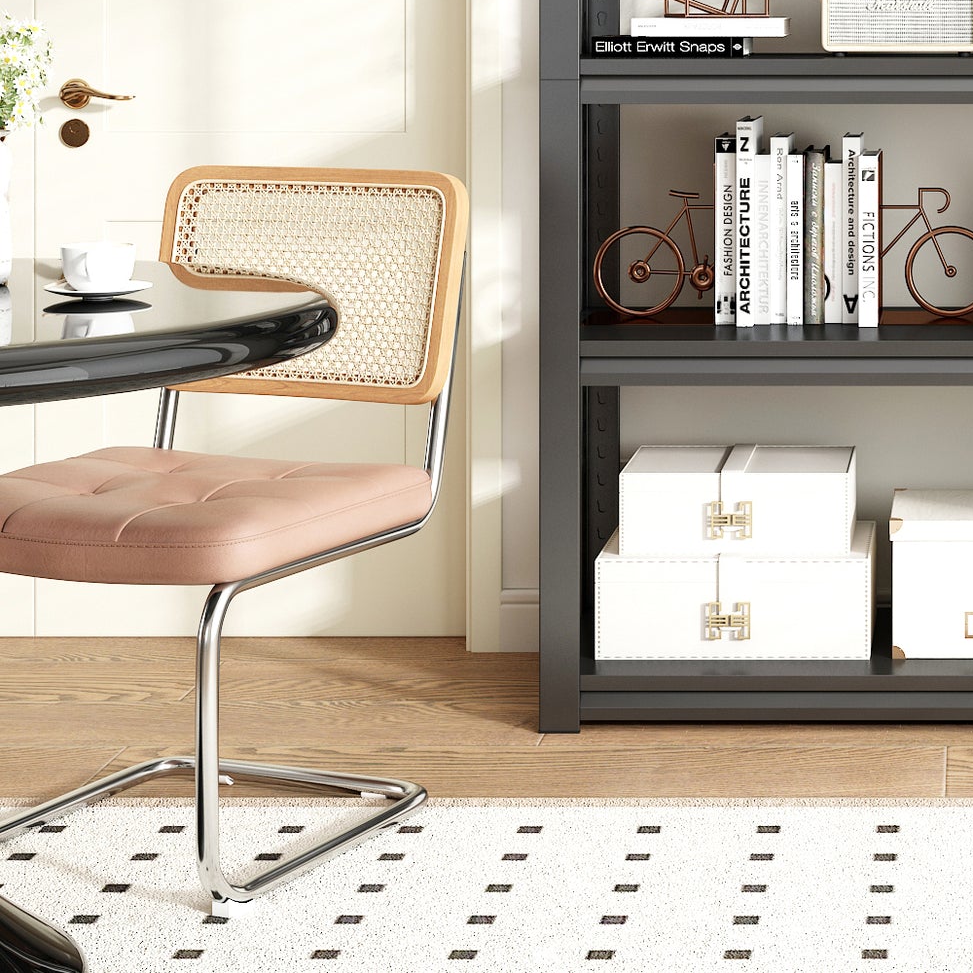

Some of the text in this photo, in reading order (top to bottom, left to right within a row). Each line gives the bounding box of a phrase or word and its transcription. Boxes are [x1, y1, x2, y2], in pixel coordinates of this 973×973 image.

[595, 40, 726, 54] Elliott Erwitt Snaps
[776, 148, 784, 169] Ron
[723, 185, 733, 276] FASHION DESIGN
[739, 177, 751, 314] ARCHITECTURE
[759, 180, 769, 314] INNENARCHITEKTUR
[790, 200, 799, 217] arts
[846, 148, 856, 276] Architecture and design
[790, 231, 800, 280] architecture
[862, 212, 875, 302] FICTIONS INC.
